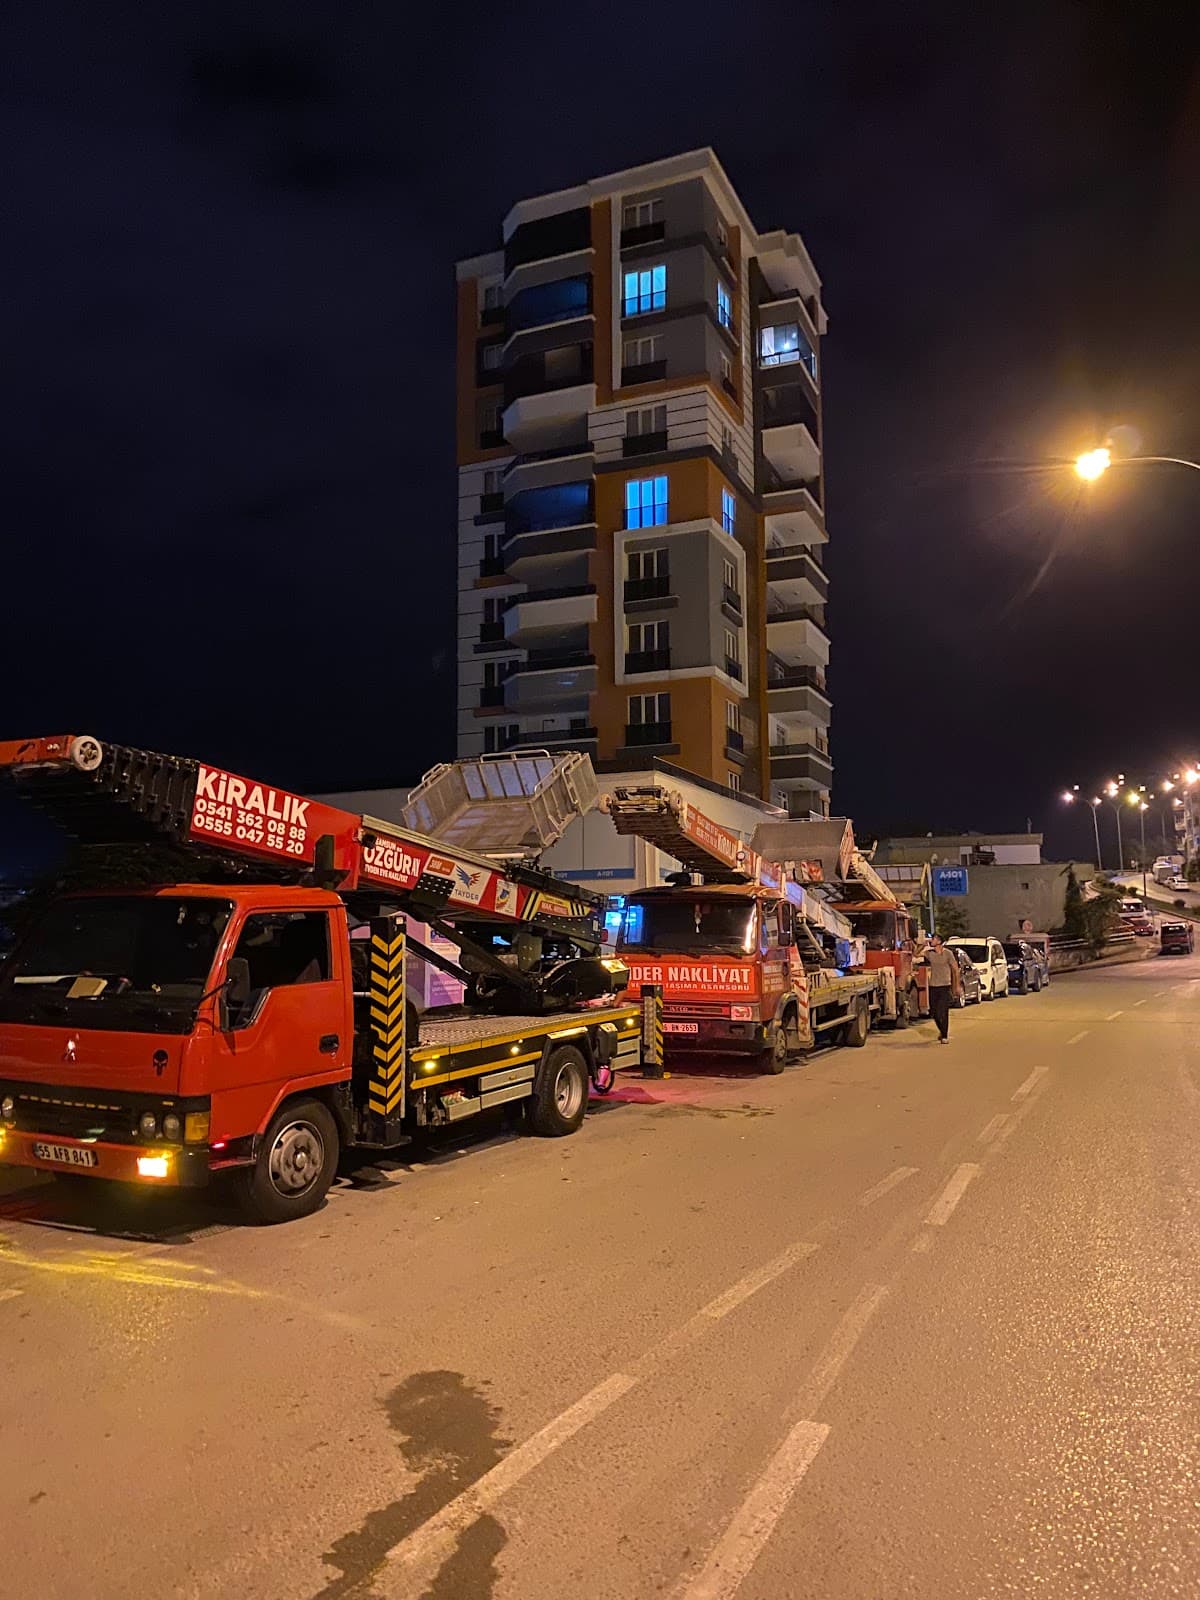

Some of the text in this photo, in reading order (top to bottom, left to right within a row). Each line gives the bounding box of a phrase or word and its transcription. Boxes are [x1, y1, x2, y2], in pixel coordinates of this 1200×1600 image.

[193, 814, 304, 855] 0555 047 55 20
[196, 799, 306, 841] 0541 362 08 88
[629, 966, 663, 981] DER
[668, 964, 751, 983] NAKLİYAT
